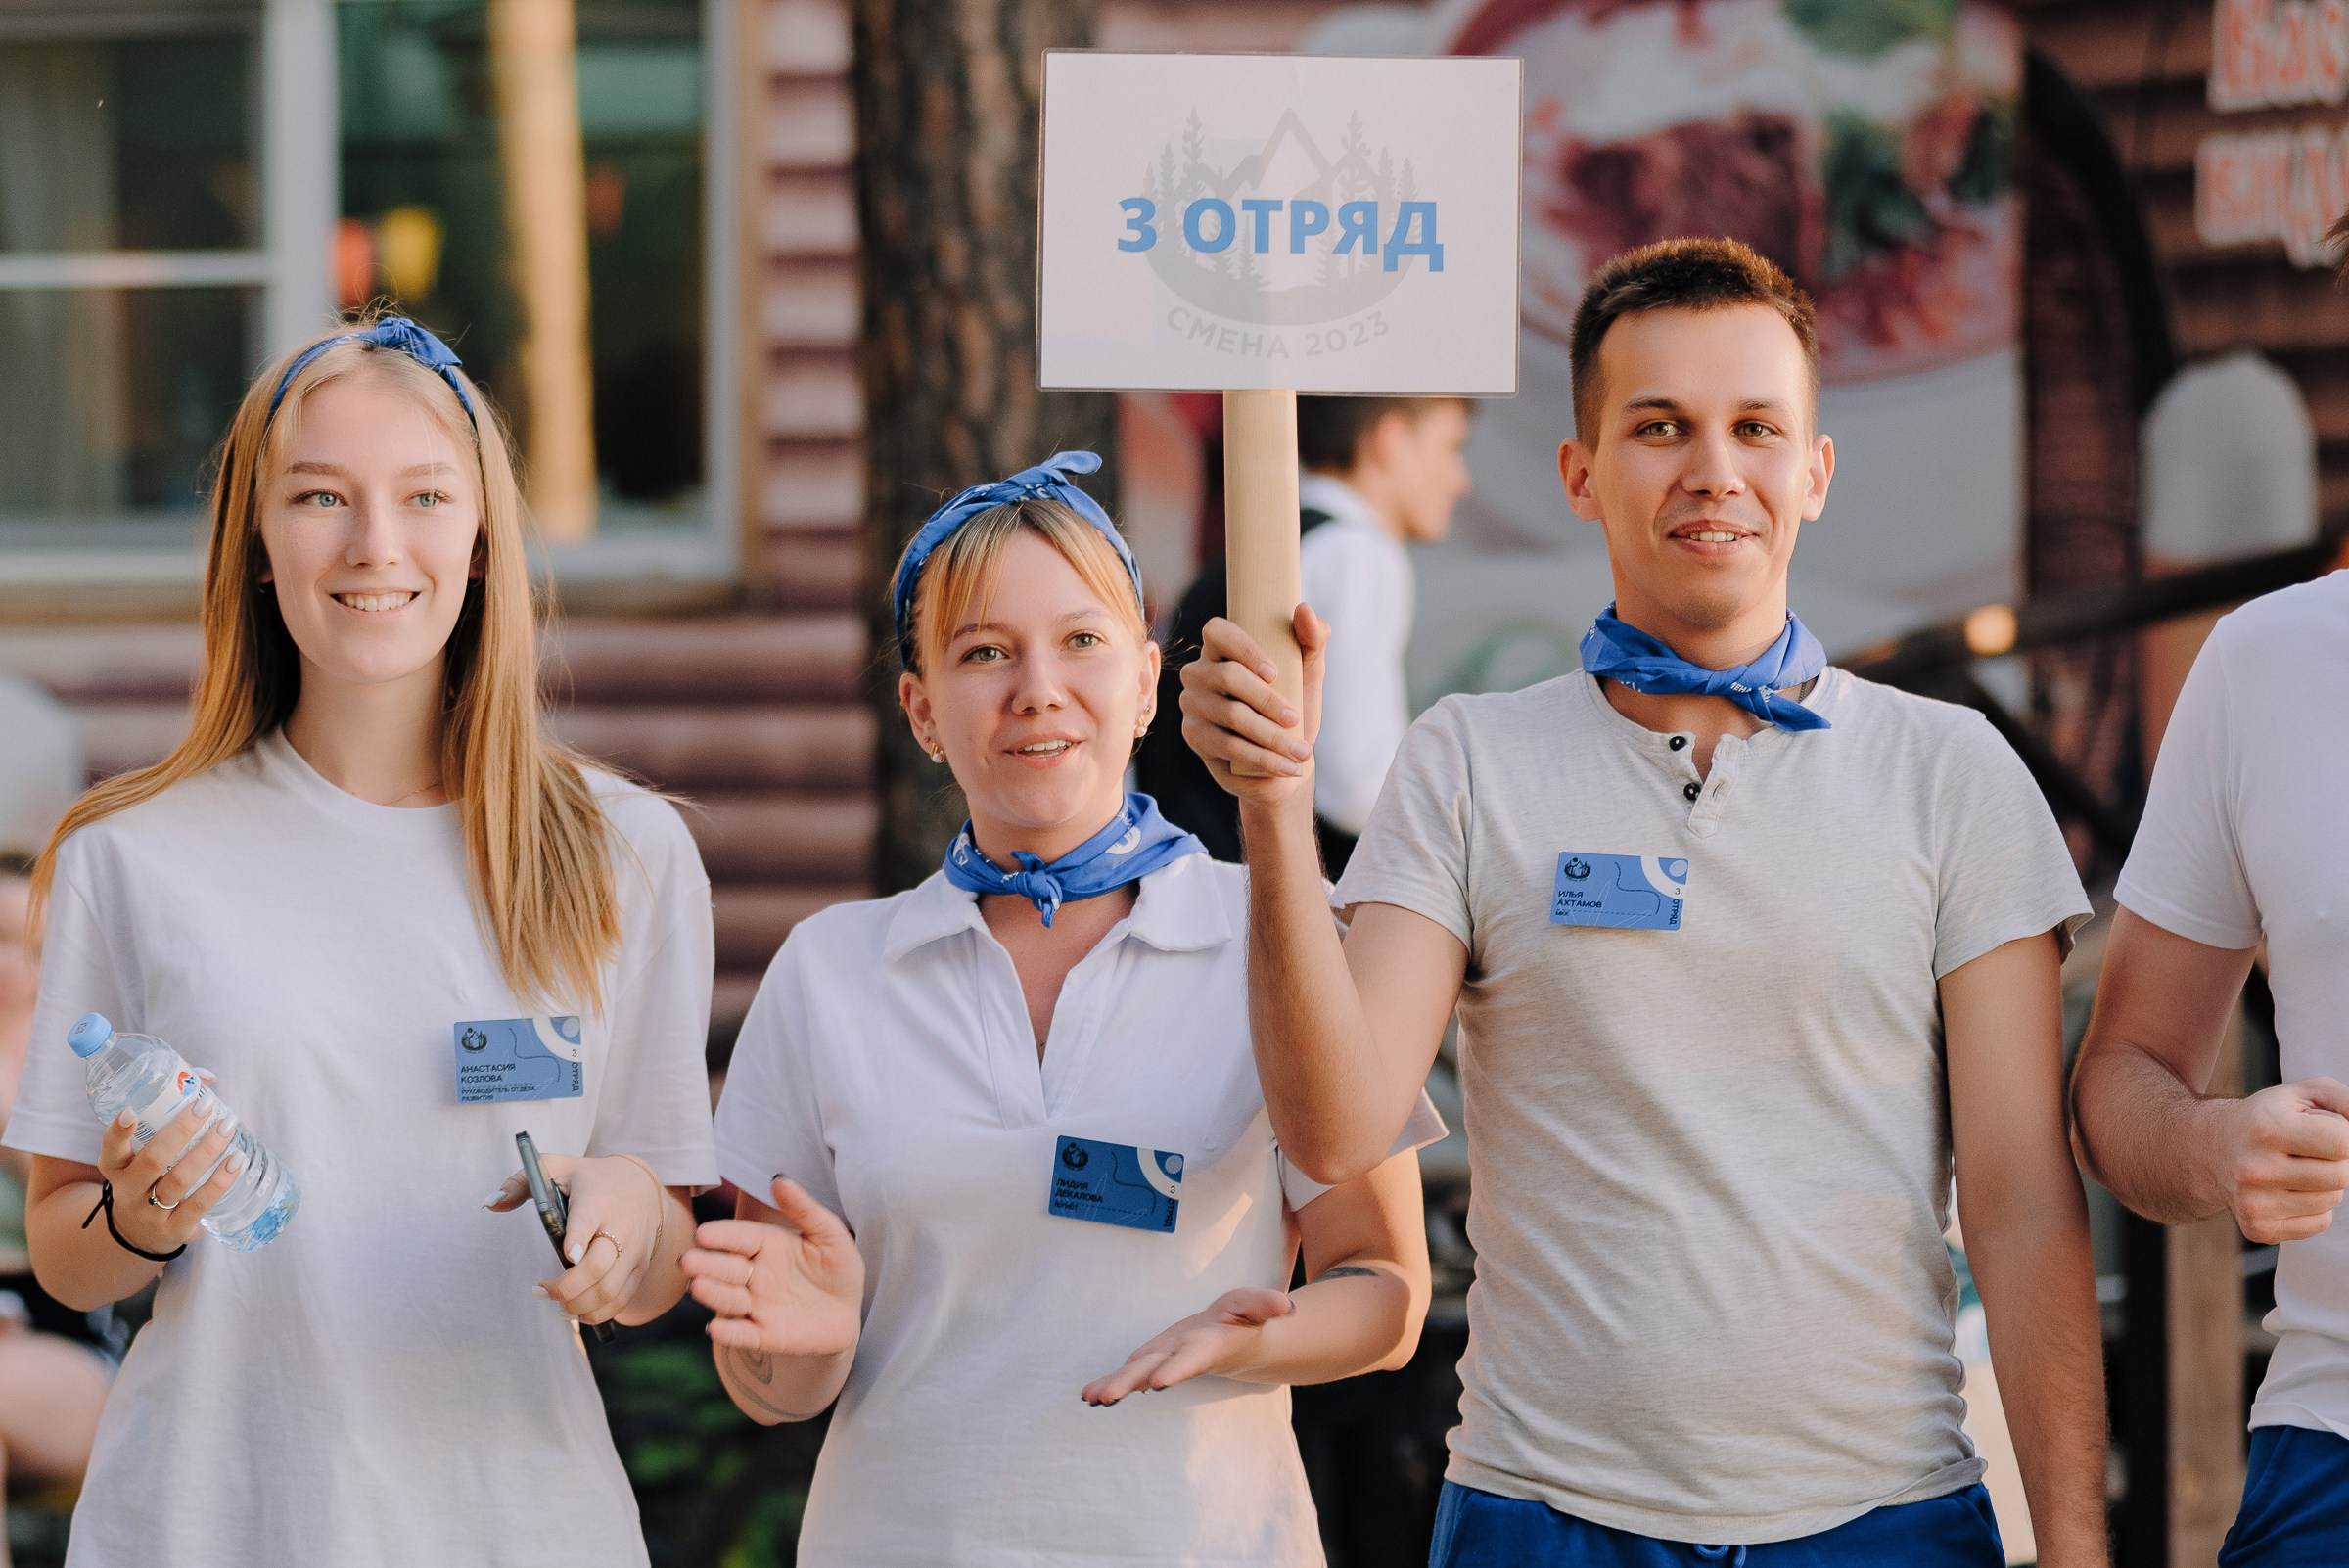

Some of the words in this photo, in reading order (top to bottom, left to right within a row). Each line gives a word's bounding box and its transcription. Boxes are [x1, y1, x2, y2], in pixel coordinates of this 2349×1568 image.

[1118, 197, 1158, 254] 3
[1183, 198, 1444, 272] ОТРЯД
[1166, 305, 1291, 359] СМЕНА
[1303, 310, 1390, 358] 2023
[1557, 890, 1584, 899] ИЛЬЯ
[1675, 887, 1681, 896] 3
[1556, 899, 1602, 908] АХТАМОВ
[1668, 899, 1680, 926] ОТРЯД
[461, 1063, 516, 1074] АНАСТАСИЯ
[461, 1075, 503, 1084] КОЗЛОВА
[1057, 1178, 1088, 1190] ЛИДИЯ
[1170, 1185, 1176, 1194] 3
[1054, 1189, 1103, 1203] ДЕКАЛОВА
